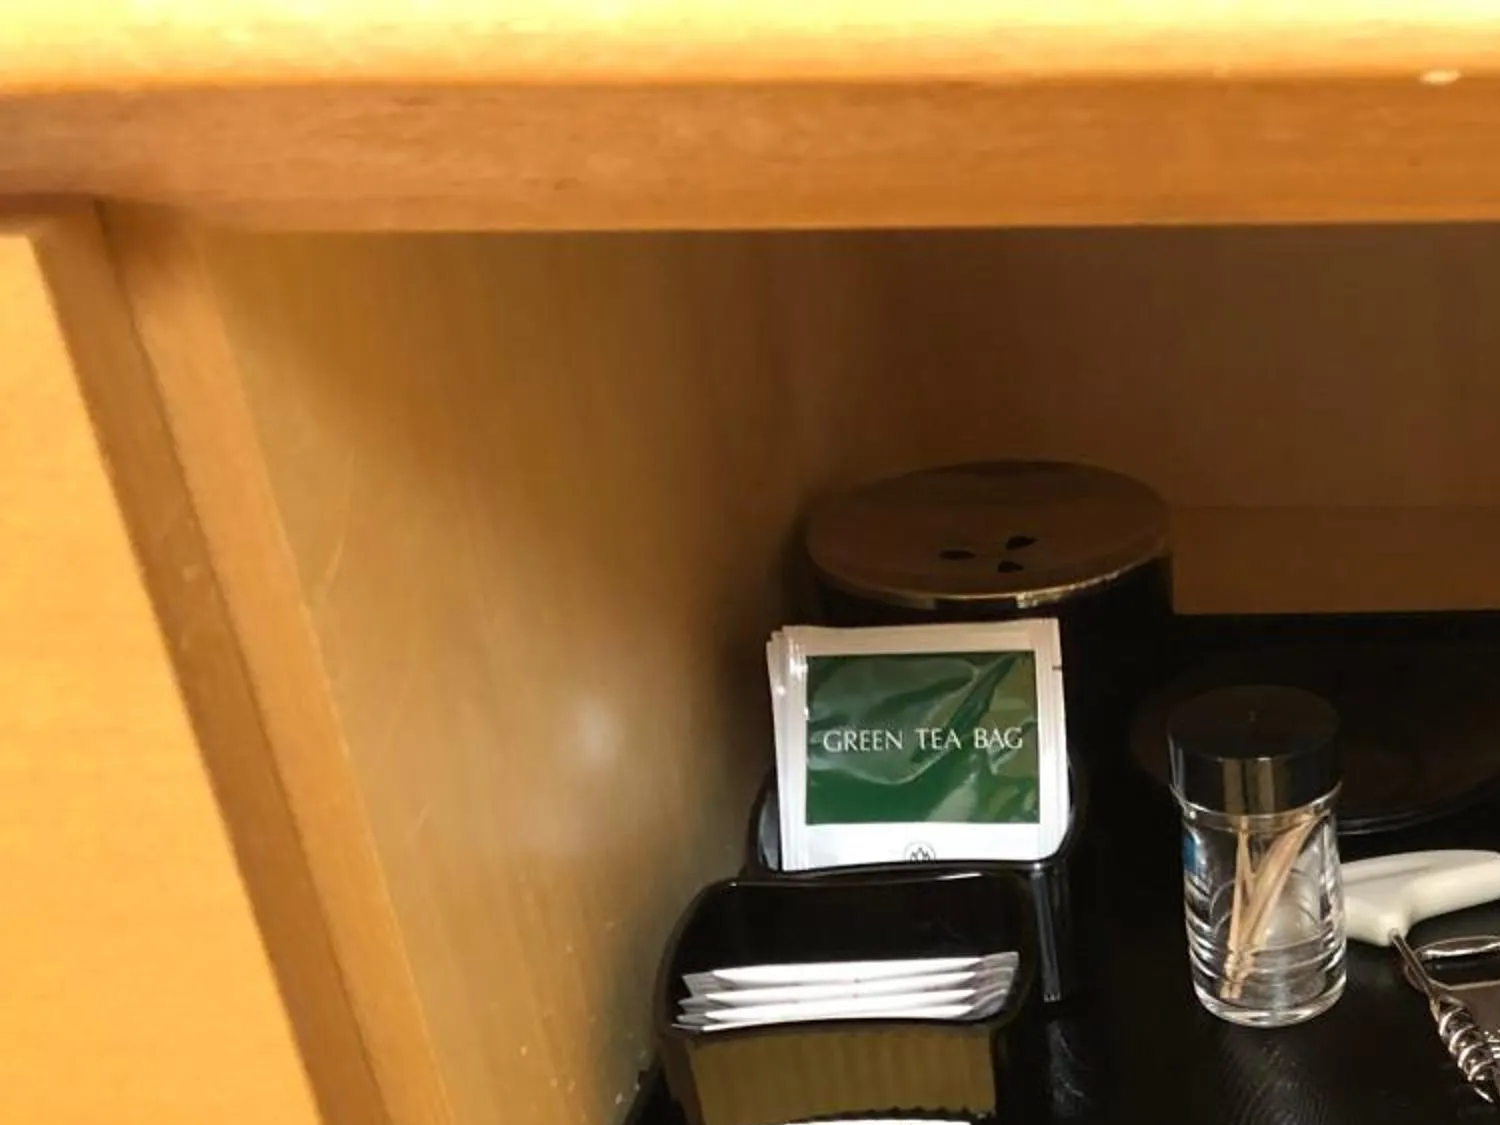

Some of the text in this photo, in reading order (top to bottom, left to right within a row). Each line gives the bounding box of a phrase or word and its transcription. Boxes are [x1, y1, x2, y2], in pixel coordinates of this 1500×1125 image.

[822, 727, 1024, 752] GREEN TEA BAG
